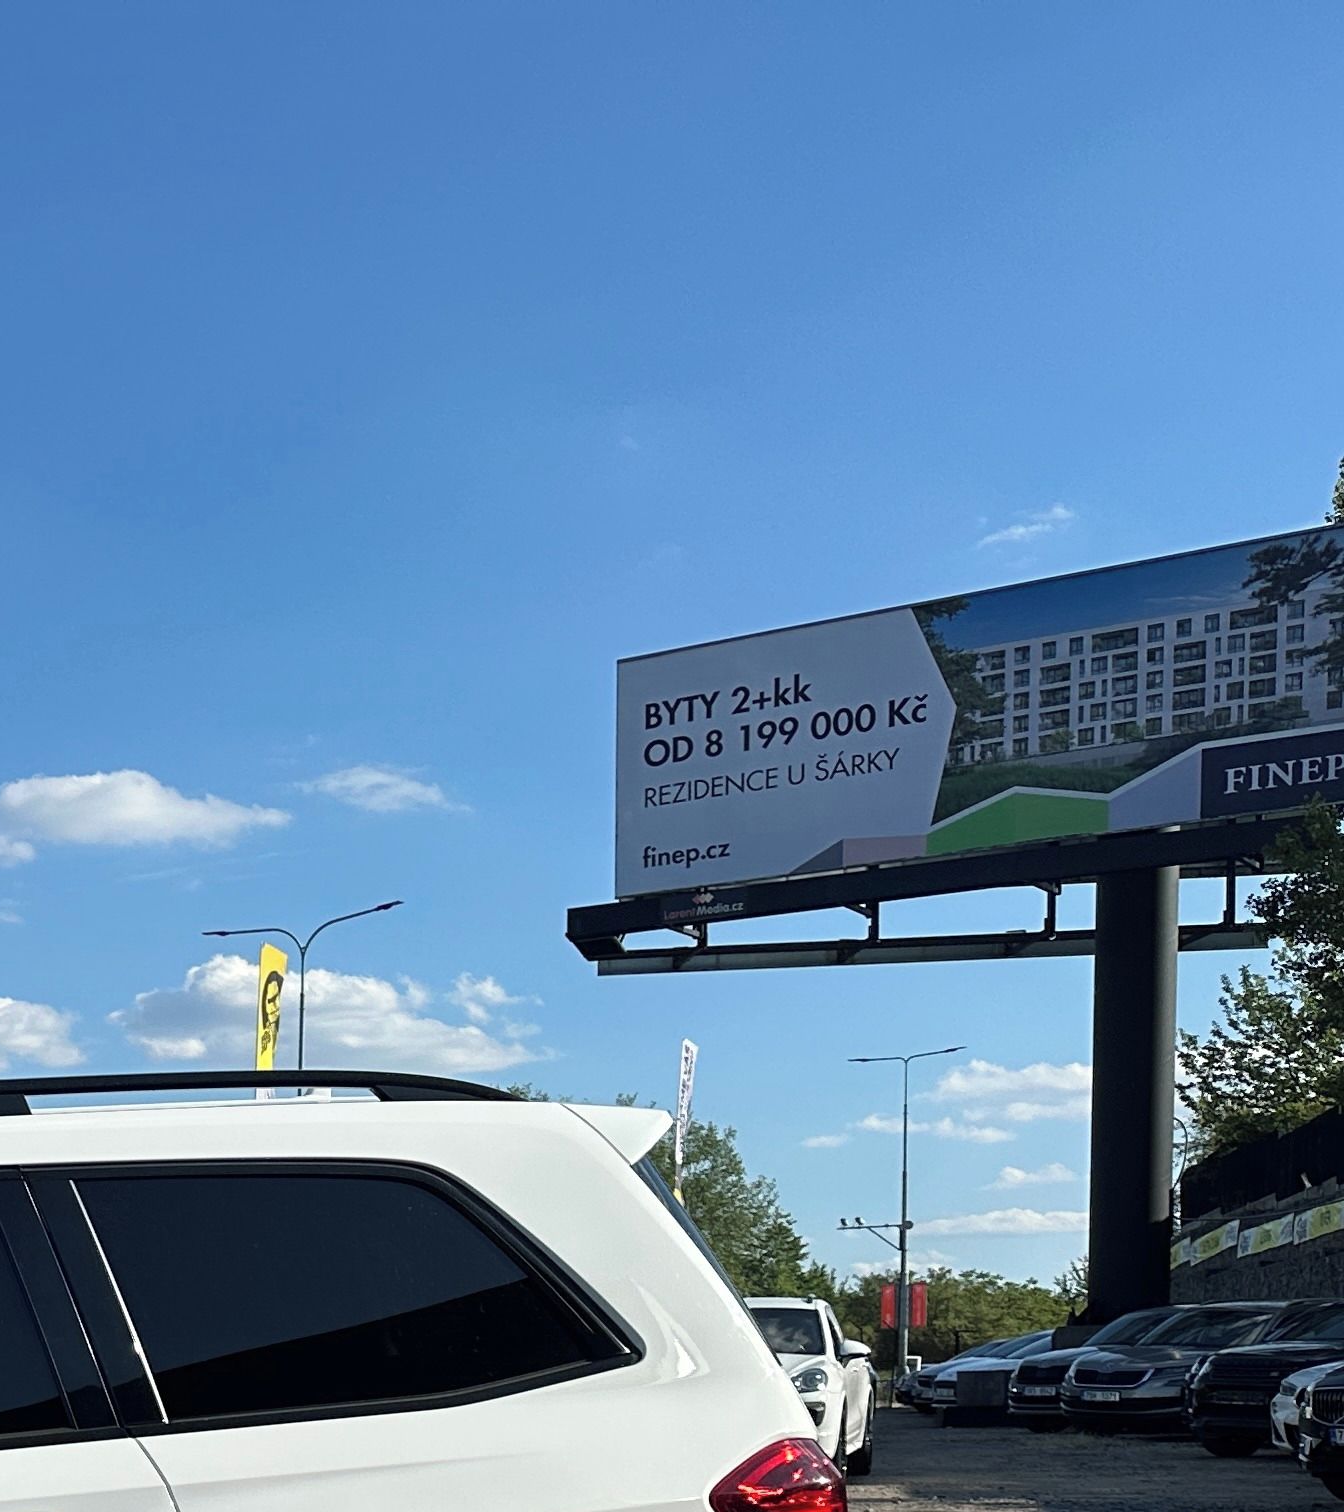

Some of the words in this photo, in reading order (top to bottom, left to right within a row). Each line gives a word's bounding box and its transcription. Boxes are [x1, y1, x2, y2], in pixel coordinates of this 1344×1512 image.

[643, 735, 694, 768] OD
[704, 729, 724, 758] 8
[739, 716, 800, 752] 199
[810, 703, 877, 740] 000
[887, 693, 929, 728] Kč
[644, 690, 721, 731] BYTY
[730, 673, 813, 715] 2+kk
[643, 767, 779, 809] REZIDENCE
[787, 762, 806, 786] U
[814, 747, 901, 782] ŠÁRKY
[1223, 752, 1344, 795] FINEP
[642, 843, 731, 869] finep.cz
